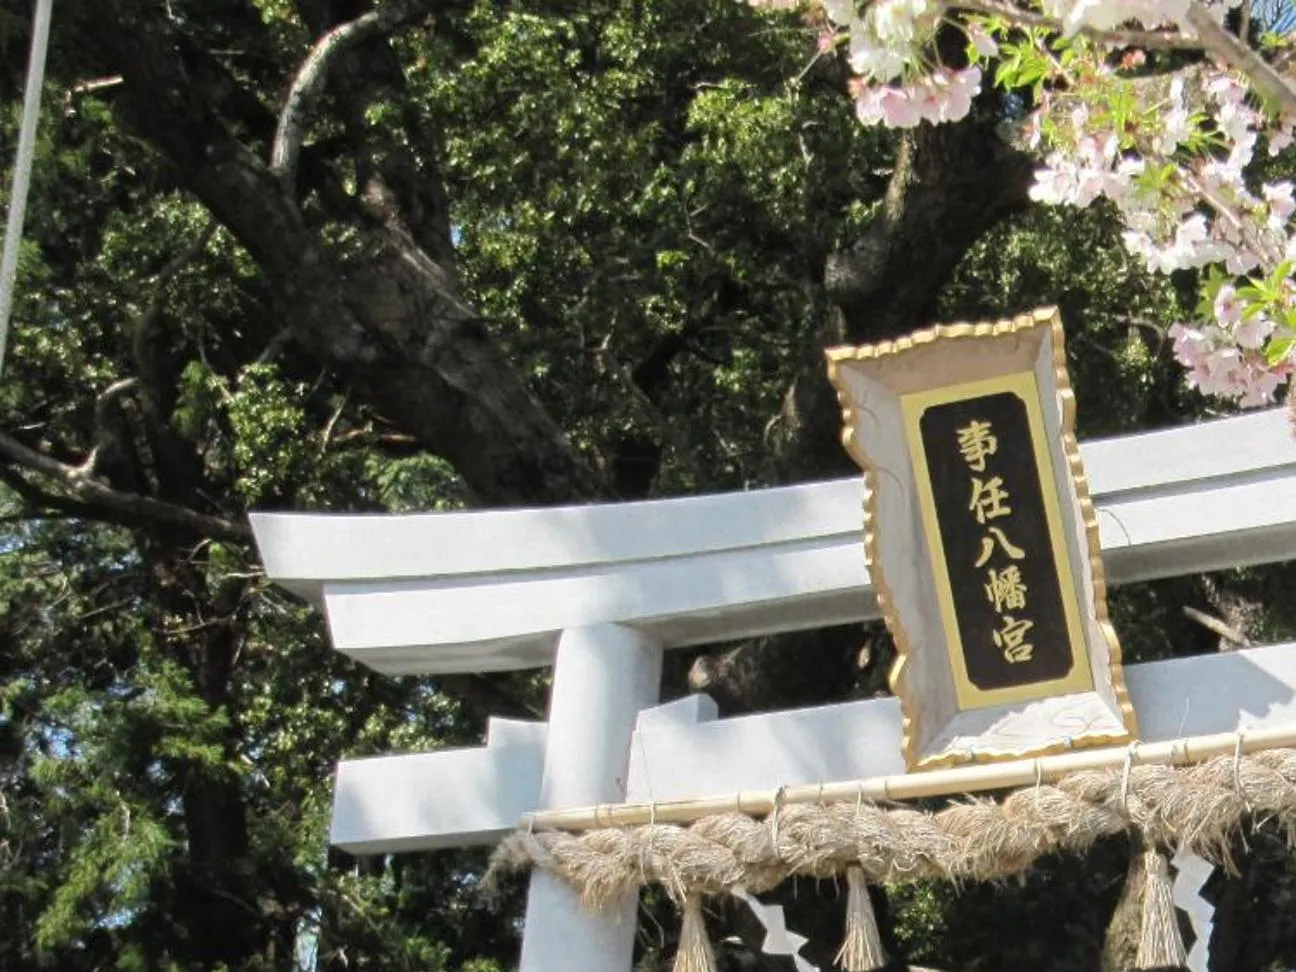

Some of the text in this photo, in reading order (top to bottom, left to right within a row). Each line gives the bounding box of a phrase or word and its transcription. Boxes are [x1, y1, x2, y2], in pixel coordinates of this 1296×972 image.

[956, 420, 1035, 664] 事任八幡宮
